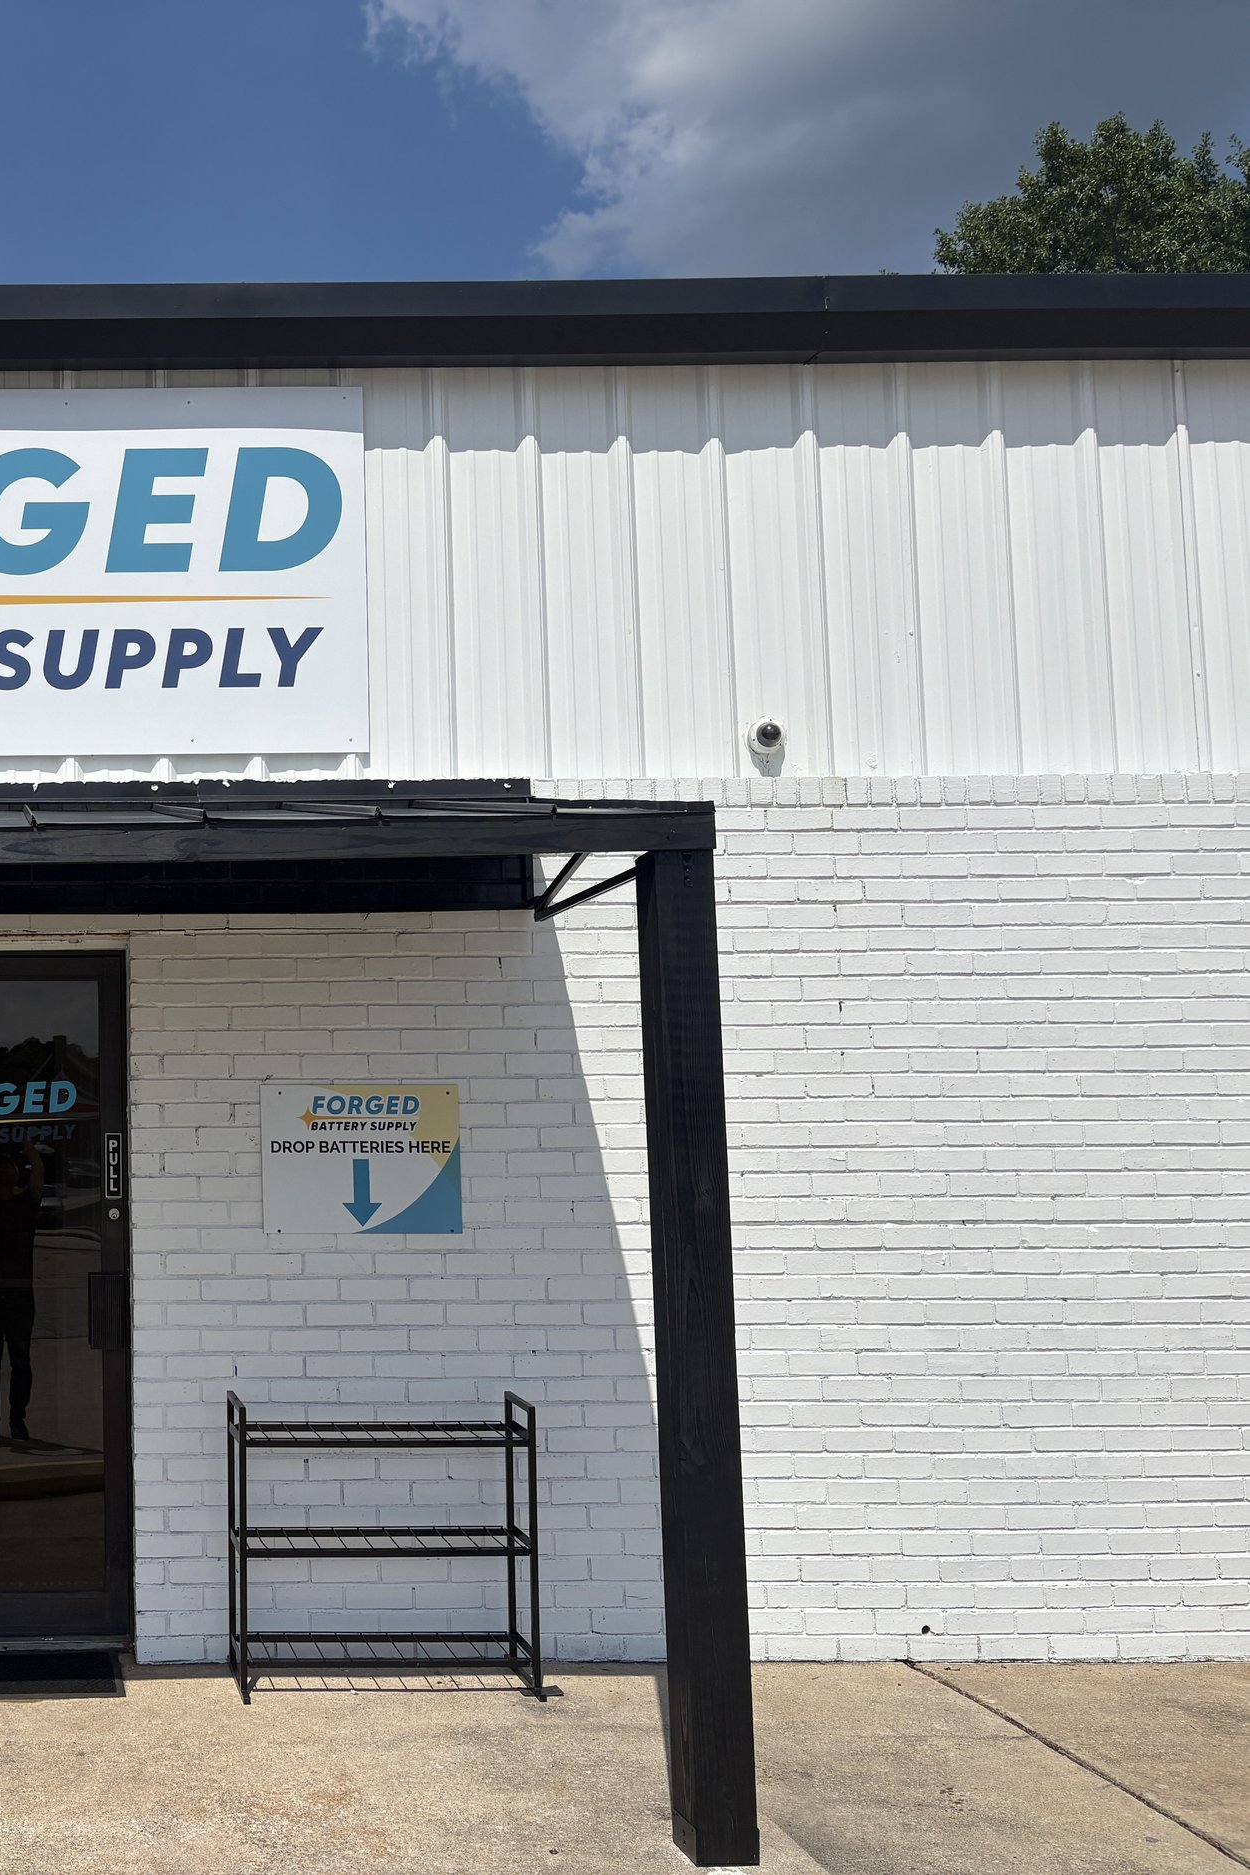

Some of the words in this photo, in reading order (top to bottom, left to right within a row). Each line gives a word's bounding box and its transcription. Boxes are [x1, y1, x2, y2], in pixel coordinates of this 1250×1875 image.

[312, 1095, 420, 1115] FORGED
[311, 1121, 367, 1131] BATTERY
[370, 1121, 417, 1131] SUPPLY
[270, 1140, 315, 1154] DROP
[319, 1140, 404, 1154] BATTERIES
[408, 1140, 451, 1154] HERE
[108, 1139, 119, 1192] PULL
